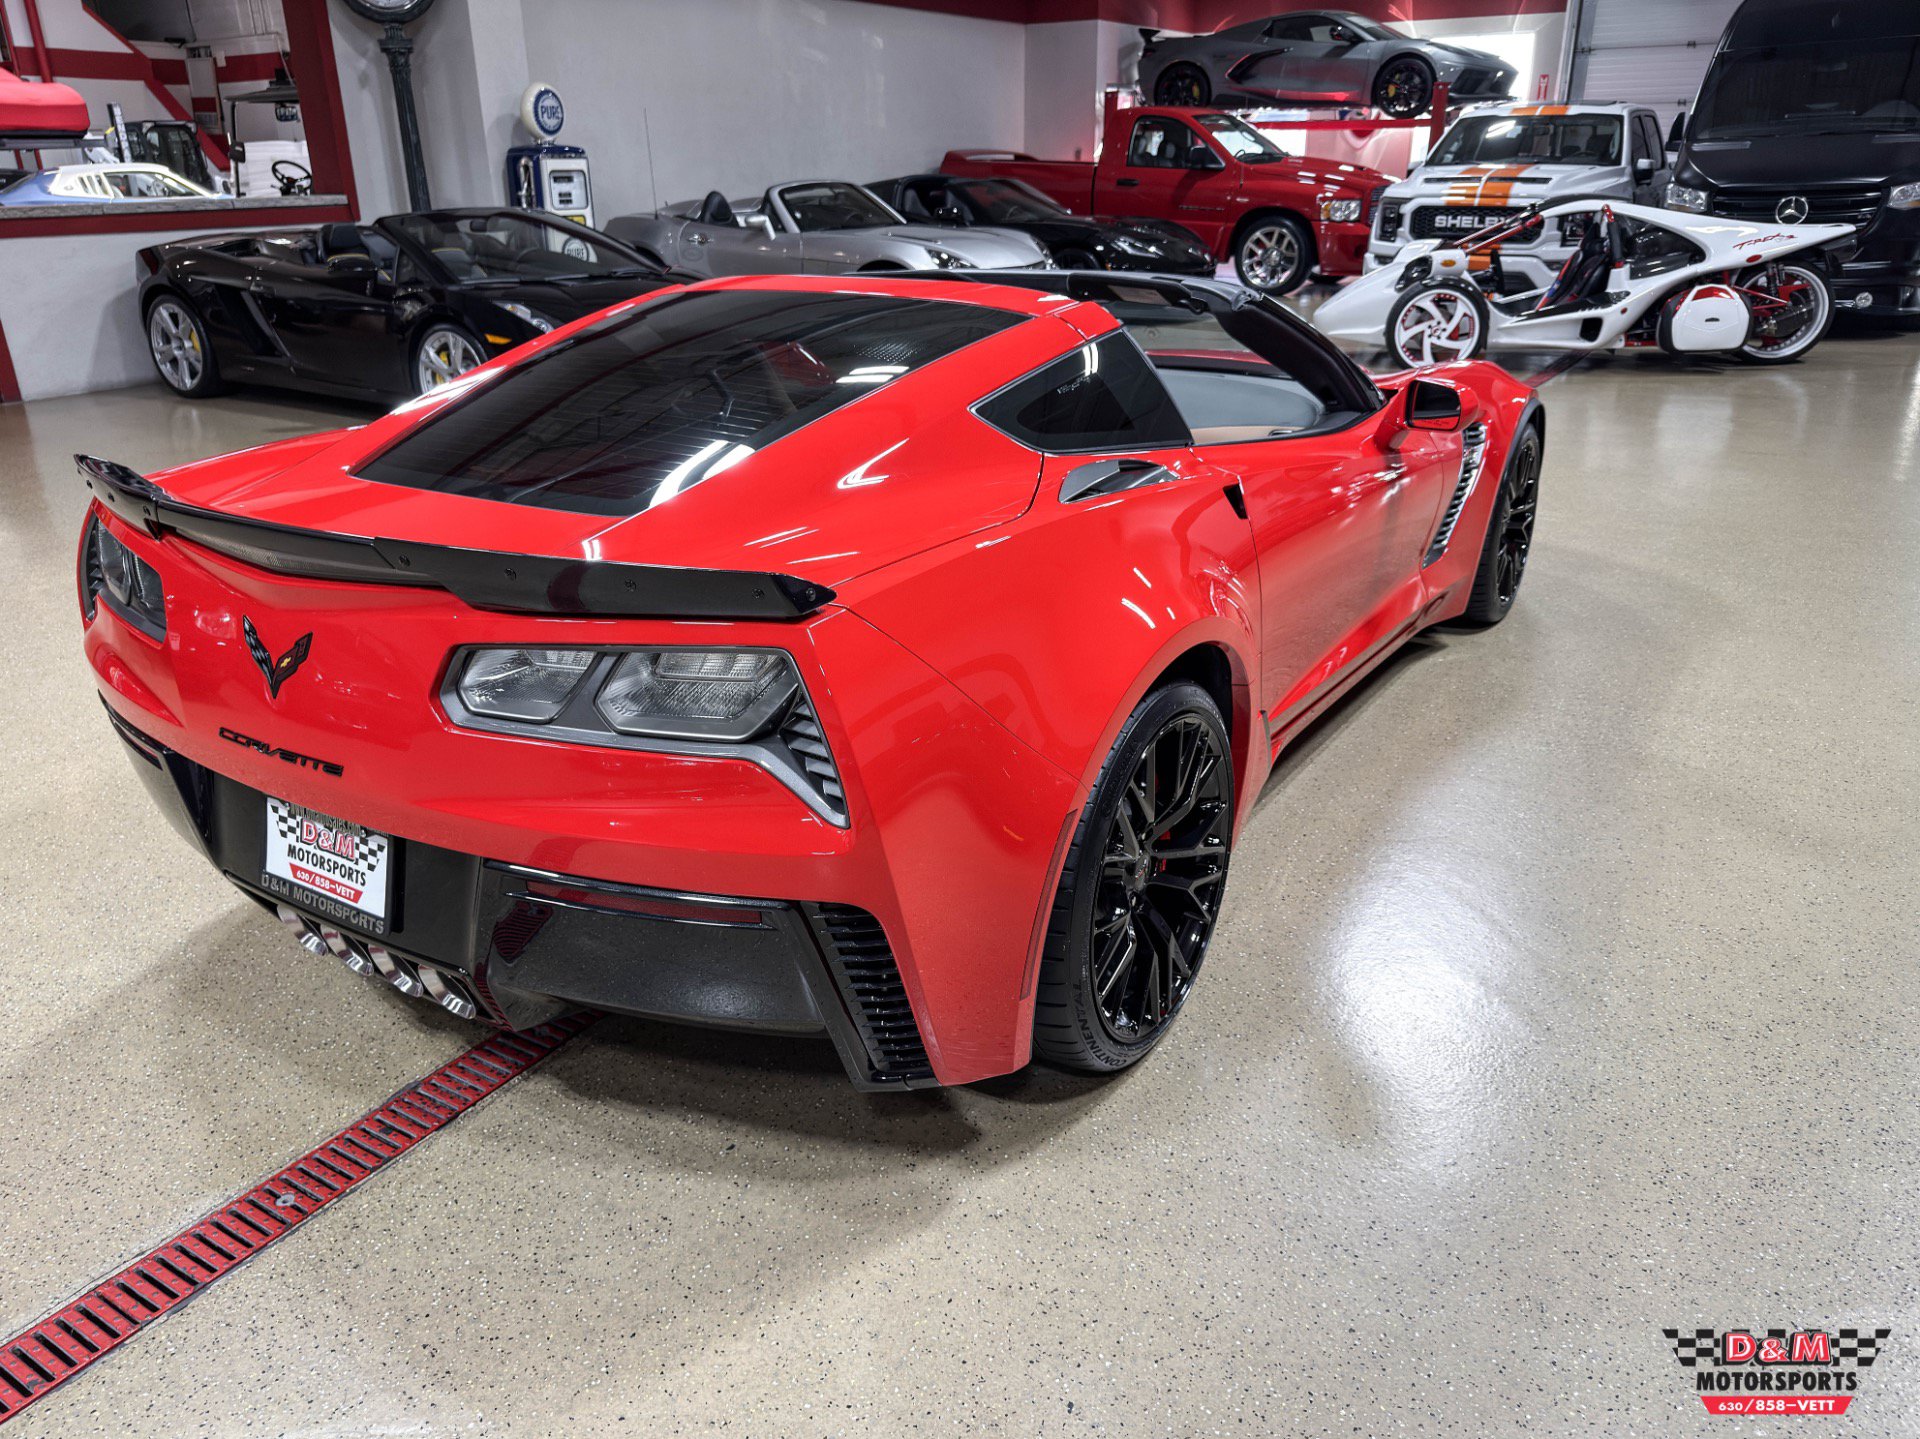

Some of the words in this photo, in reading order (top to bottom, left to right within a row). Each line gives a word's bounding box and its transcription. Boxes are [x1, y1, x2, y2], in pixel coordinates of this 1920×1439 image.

[540, 105, 560, 120] PURE
[1434, 214, 1505, 229] SHELB
[218, 726, 345, 778] CORVETTE
[301, 818, 356, 861] D&M
[287, 843, 367, 887] MOTORSPORTS
[296, 870, 356, 900] 630/858-VETT
[261, 873, 290, 897] D&M
[293, 886, 385, 935] MOTORSPORTS
